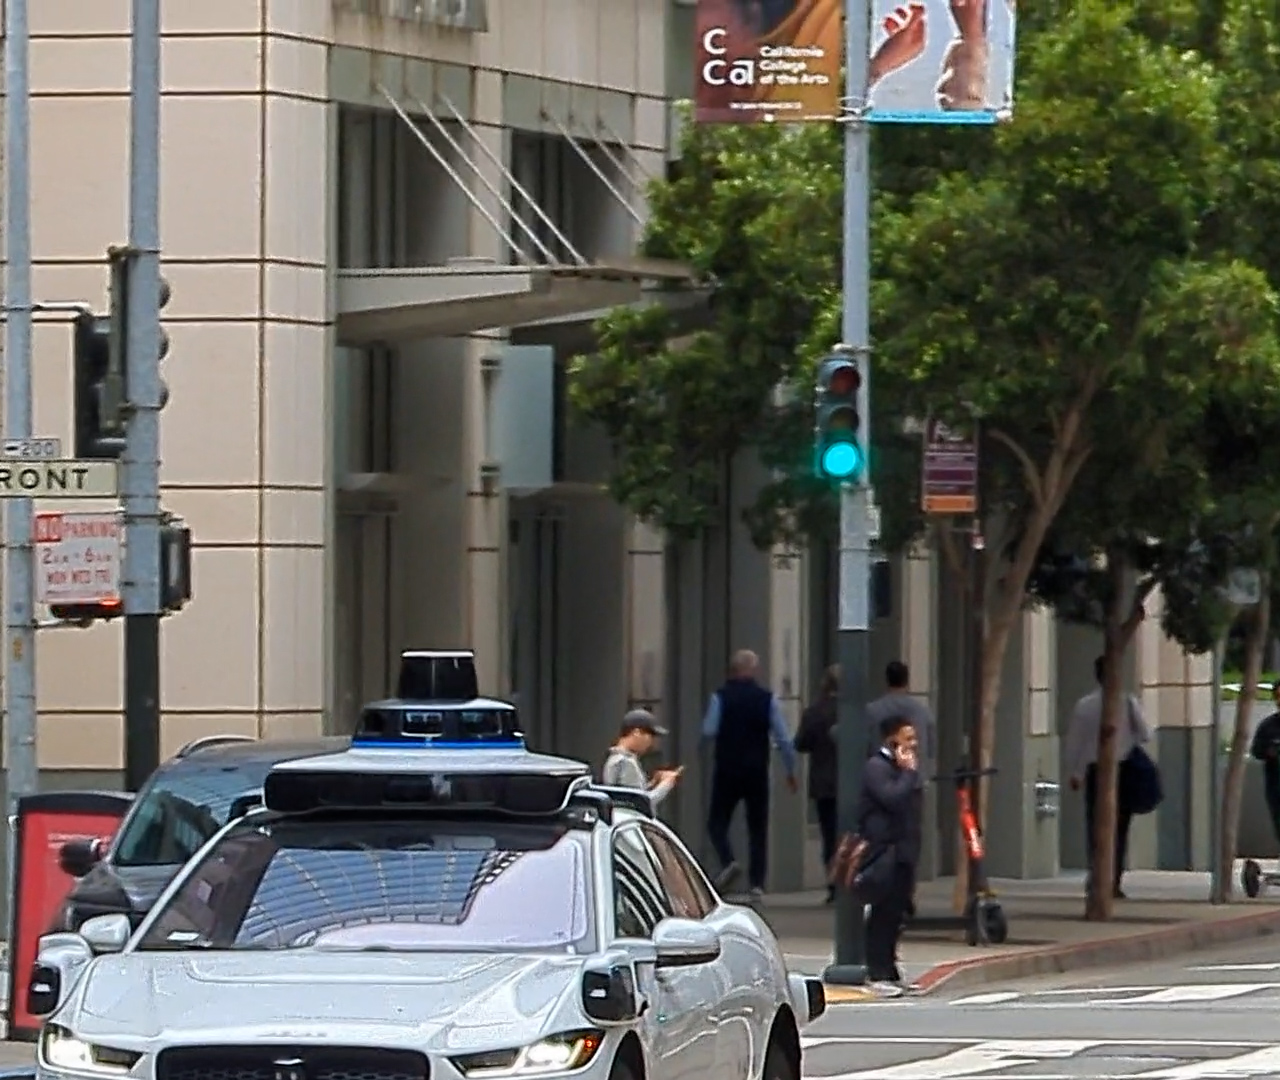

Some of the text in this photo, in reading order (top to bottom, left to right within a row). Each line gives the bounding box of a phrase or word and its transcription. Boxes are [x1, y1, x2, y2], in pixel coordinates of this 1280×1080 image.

[703, 28, 727, 55] C
[759, 46, 824, 57] California
[759, 60, 806, 73] College
[759, 74, 829, 85] of the Arts
[22, 442, 53, 456] 200
[63, 522, 117, 537] PARKING
